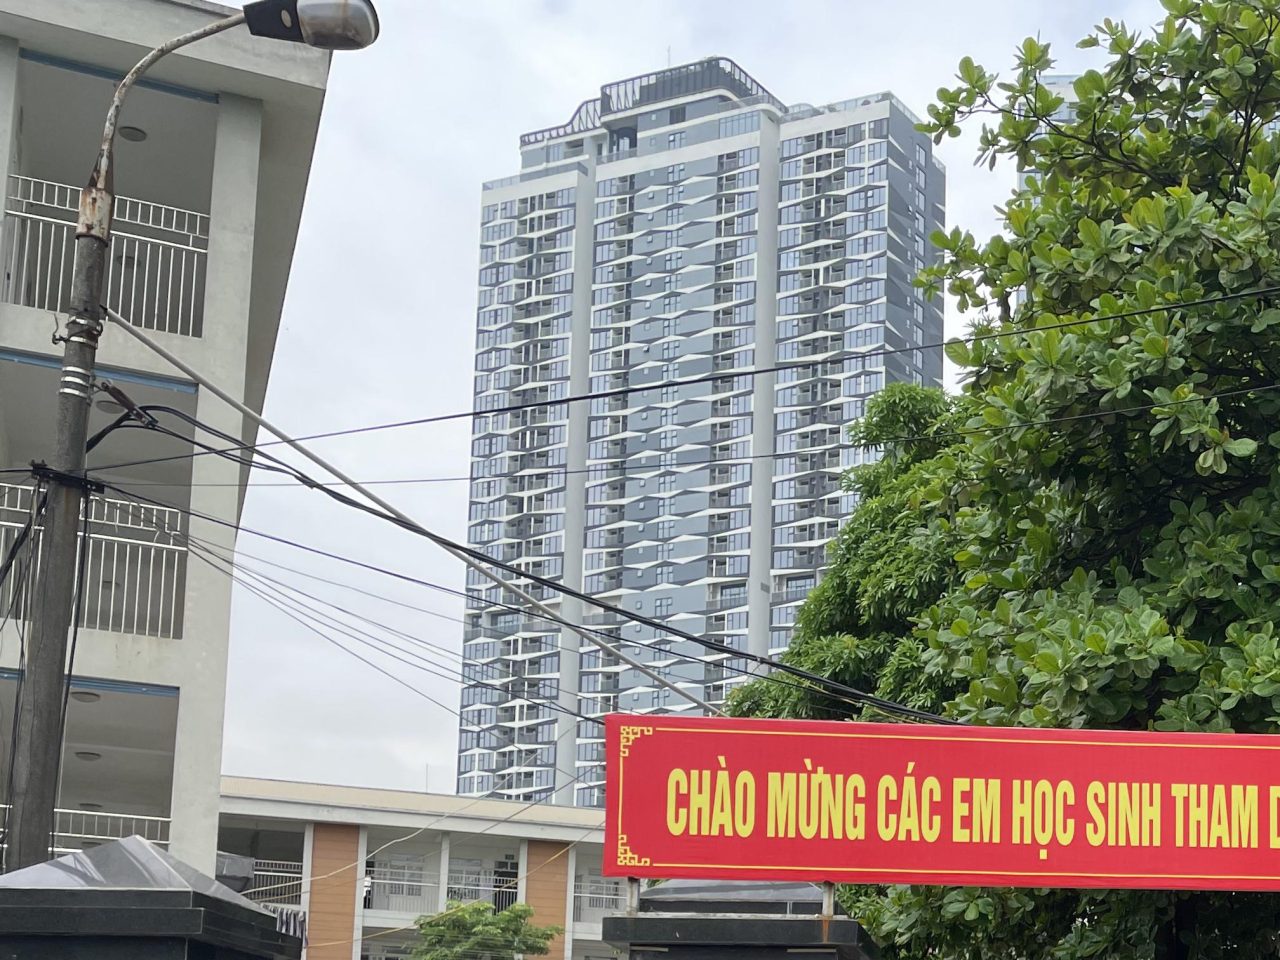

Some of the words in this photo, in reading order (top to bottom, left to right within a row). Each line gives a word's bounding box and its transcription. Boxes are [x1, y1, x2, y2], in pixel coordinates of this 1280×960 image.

[667, 756, 755, 837] CHÀO
[767, 759, 865, 840] MỪNG
[877, 762, 941, 842] CÁC
[953, 778, 1000, 843] EM
[1012, 780, 1074, 859] HỌC
[1086, 782, 1161, 846] SINH
[1171, 784, 1258, 848] THAM
